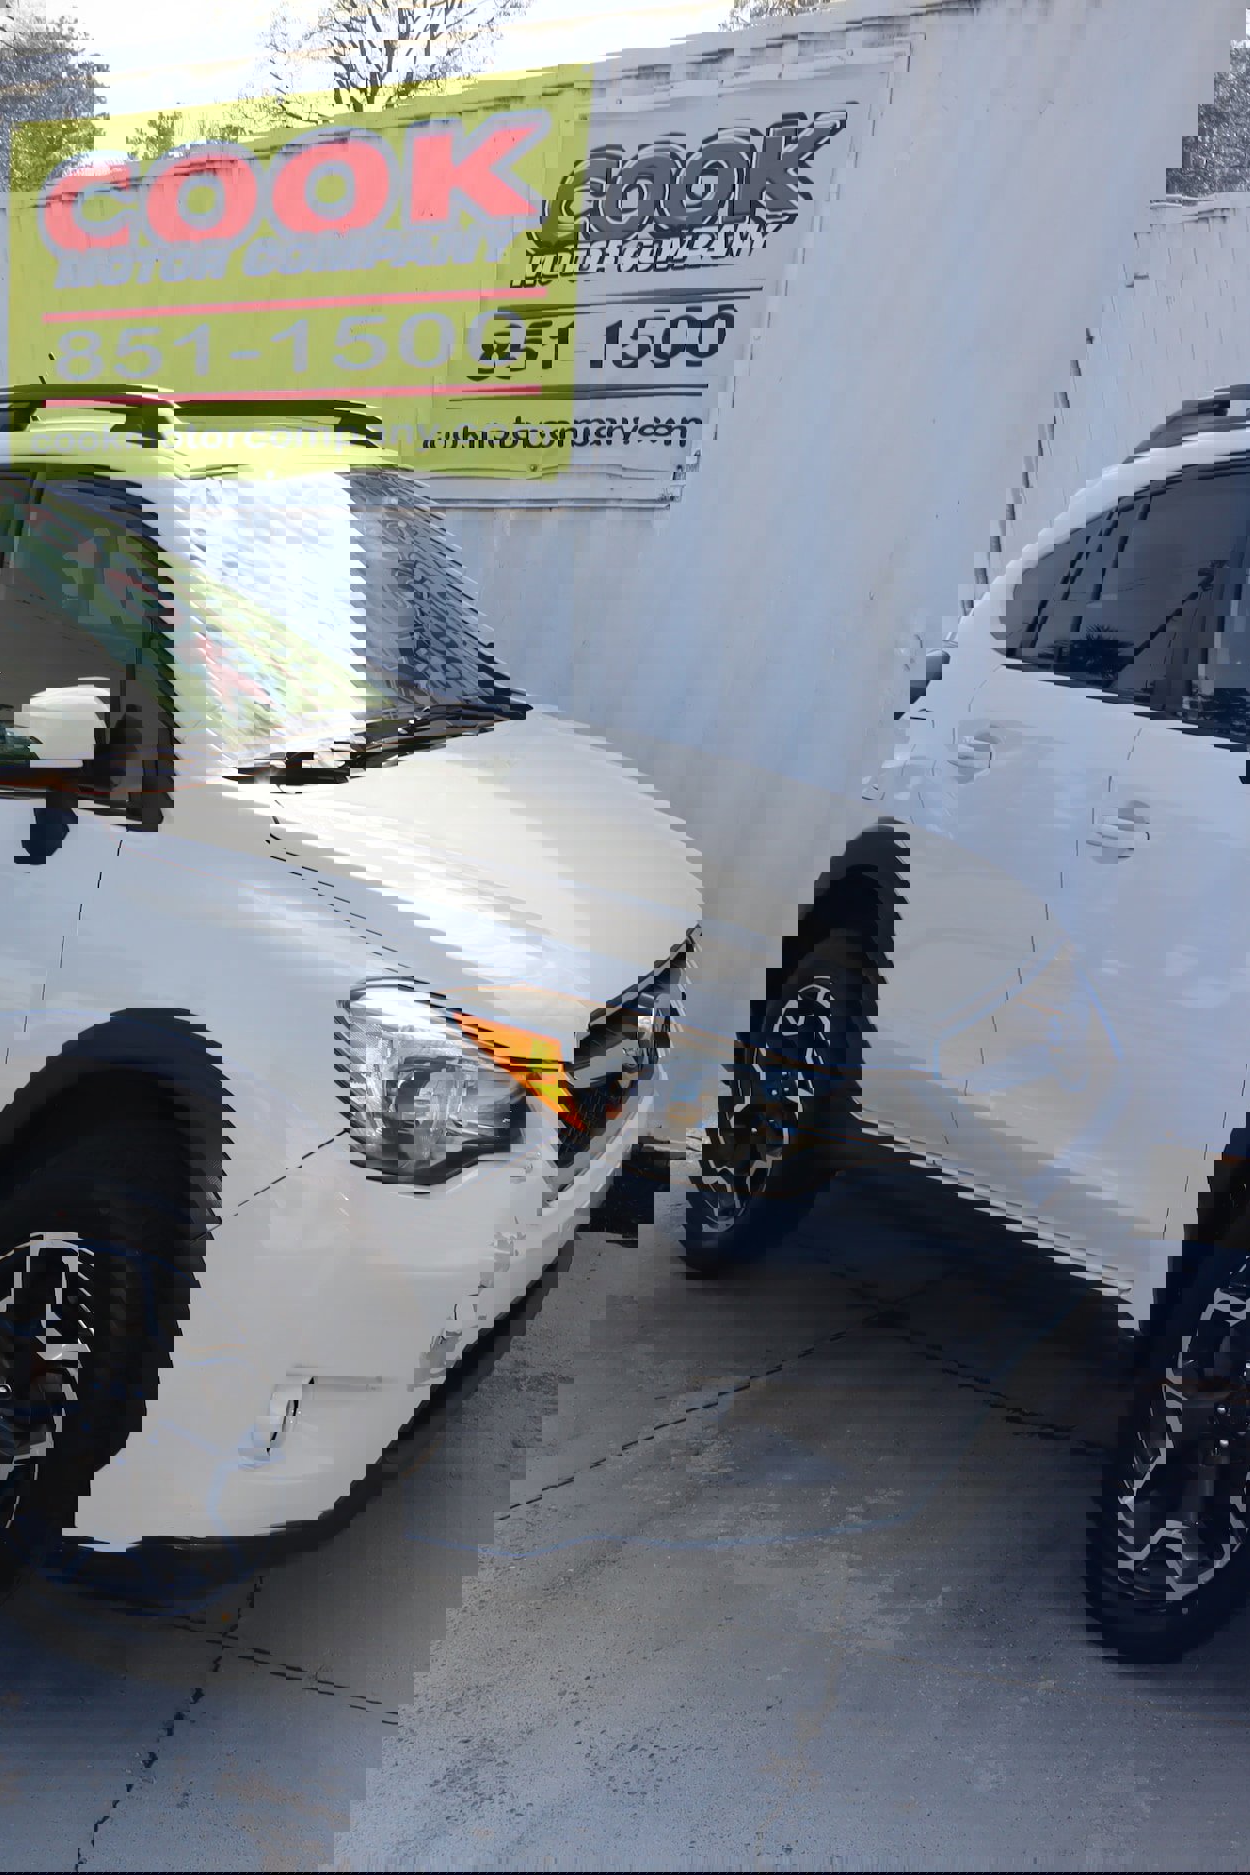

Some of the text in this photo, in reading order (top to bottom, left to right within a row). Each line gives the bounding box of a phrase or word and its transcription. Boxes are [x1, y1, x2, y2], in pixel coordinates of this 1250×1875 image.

[36, 109, 551, 254] COOK
[54, 225, 522, 289] MOTOR COMPANY
[55, 310, 527, 382] 851-1500
[31, 422, 552, 455] cookmotorcompany.com
